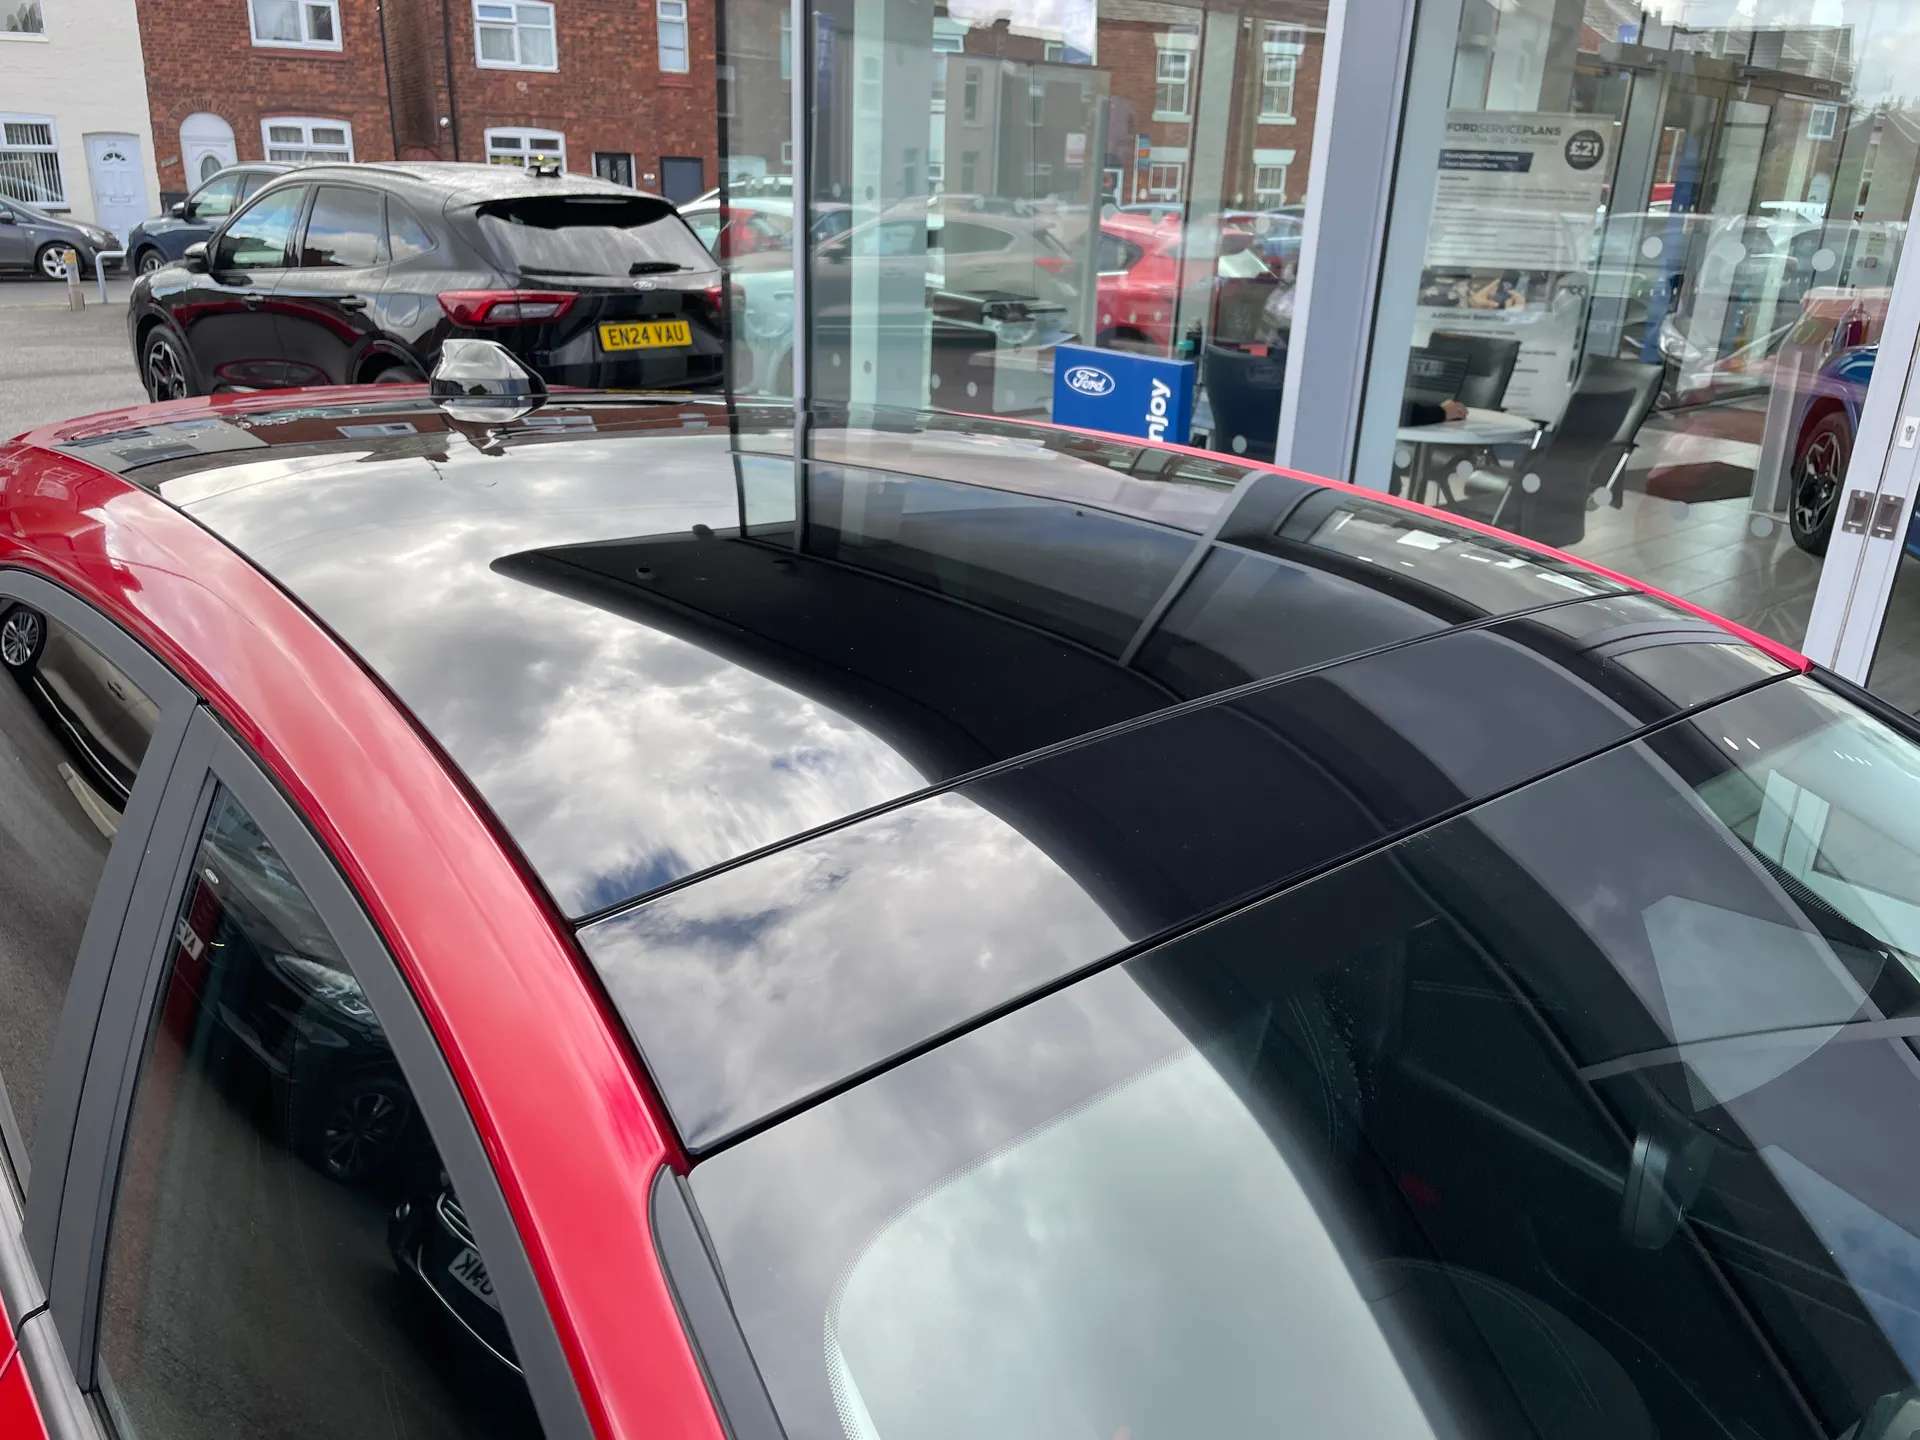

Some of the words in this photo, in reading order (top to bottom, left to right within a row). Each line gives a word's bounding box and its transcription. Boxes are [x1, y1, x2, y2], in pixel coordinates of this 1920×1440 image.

[1569, 141, 1600, 157] £21
[608, 326, 650, 346] EN24
[654, 325, 684, 343] VAU
[1072, 369, 1106, 392] Ford
